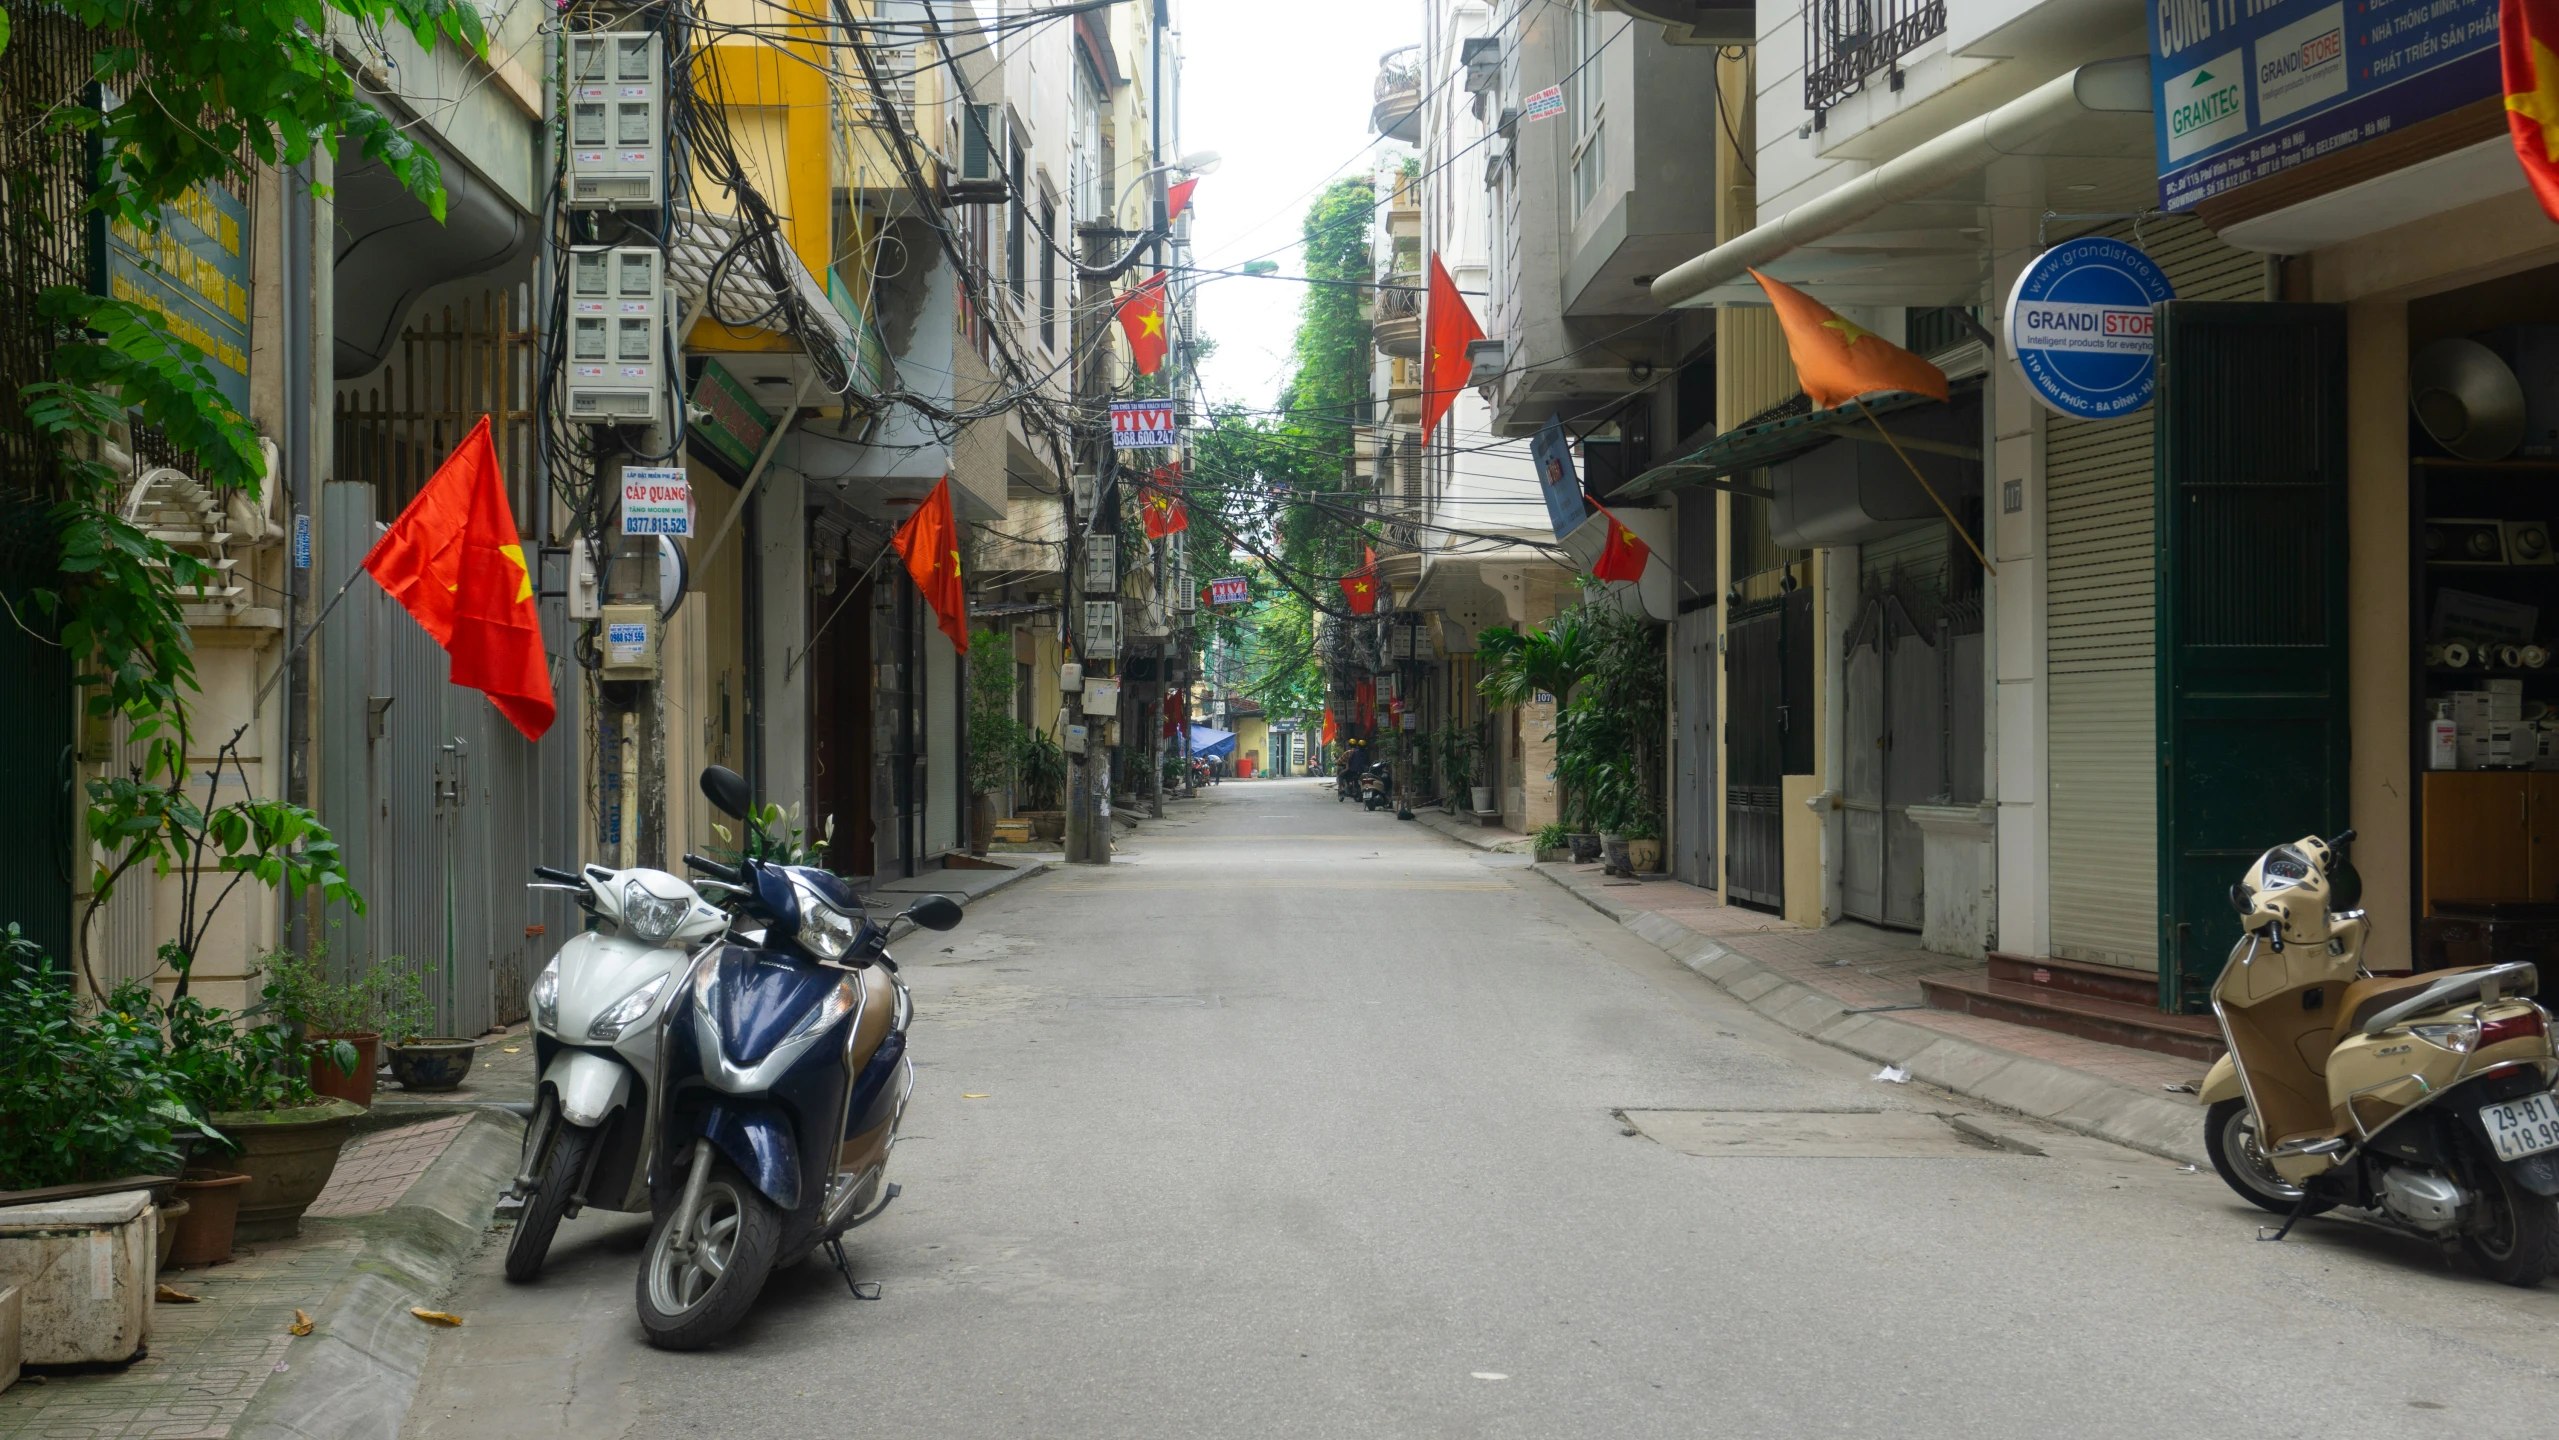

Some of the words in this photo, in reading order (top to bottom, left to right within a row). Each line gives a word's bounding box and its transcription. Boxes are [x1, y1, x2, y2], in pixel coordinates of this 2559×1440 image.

[2371, 19, 2393, 44] NHÀ
[2394, 7, 2429, 33] THÔNG
[2260, 50, 2301, 84] GRANDI
[2303, 33, 2339, 67] STORE
[2373, 50, 2402, 77] PHÁT
[2404, 31, 2438, 64] TRIỂN
[2441, 23, 2465, 49] SẢN
[2172, 84, 2239, 134] GRANTEC
[2316, 128, 2359, 155] GELEXIMCO
[2364, 121, 2376, 136] Hà
[2376, 115, 2391, 132] Nội
[2187, 172, 2200, 187] 119
[2250, 149, 2260, 163] Ba
[2281, 136, 2292, 151] Hà
[2292, 130, 2306, 147] Nội
[2029, 244, 2165, 298] www.grandistore.vn
[2027, 311, 2099, 332] GRANDI
[2027, 335, 2067, 348] Intelligent
[2069, 338, 2105, 348] products
[2106, 339, 2118, 349] for
[2026, 353, 2041, 373] 119
[2038, 371, 2061, 396] VĨNH
[2060, 391, 2088, 410] PHÚC
[2096, 402, 2110, 411] BA
[2112, 393, 2138, 410] ĐÌNH
[1111, 409, 1174, 432] TIVI
[1113, 430, 1175, 446] 0368.600.247
[649, 486, 686, 503] QUANG
[2006, 486, 2020, 509] 117
[626, 517, 687, 533] 0377.815.529
[1213, 581, 1247, 595] TIVI
[1537, 693, 1551, 702] 107
[759, 960, 796, 972] HONDA
[2492, 1097, 2549, 1131] 29-B1
